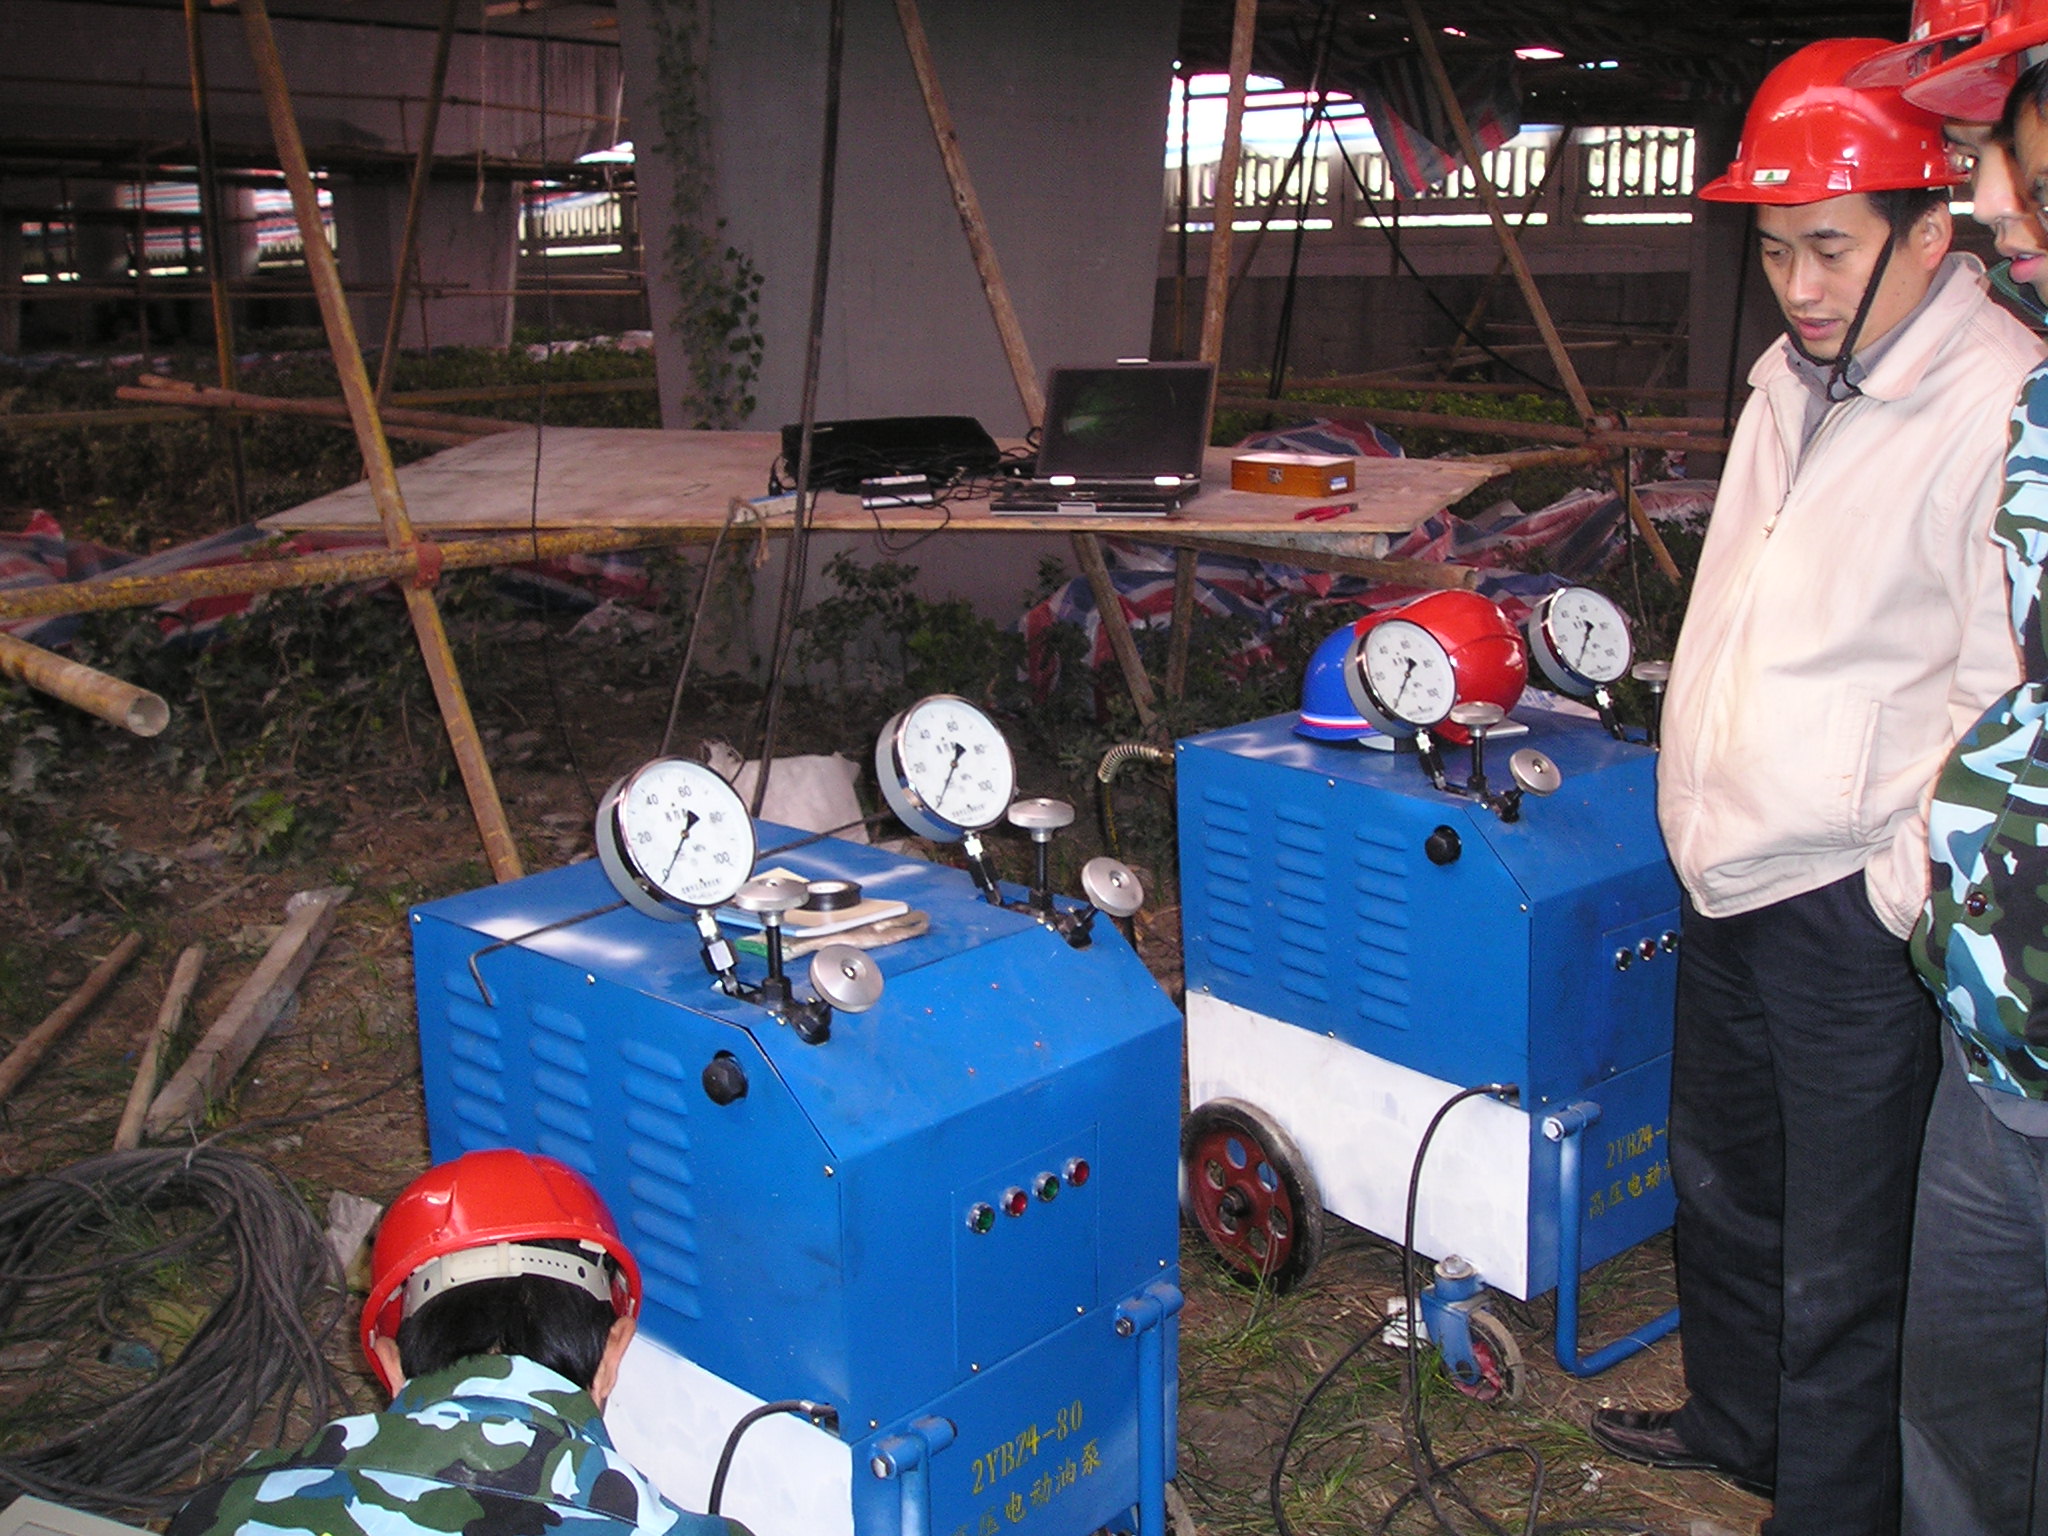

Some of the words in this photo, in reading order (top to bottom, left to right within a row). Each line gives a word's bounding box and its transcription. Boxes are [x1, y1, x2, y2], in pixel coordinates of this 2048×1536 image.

[946, 721, 959, 732] 60
[920, 729, 931, 740] 40
[974, 744, 985, 755] 80
[914, 762, 926, 774] 20
[678, 785, 692, 798] 60
[977, 780, 993, 791] 100
[646, 793, 659, 805] 40
[709, 811, 723, 824] 80
[637, 831, 652, 844] 20
[713, 851, 730, 864] 100
[1606, 1118, 1669, 1170] 2YBZ4-
[971, 1399, 1083, 1496] 2YBZ4-80
